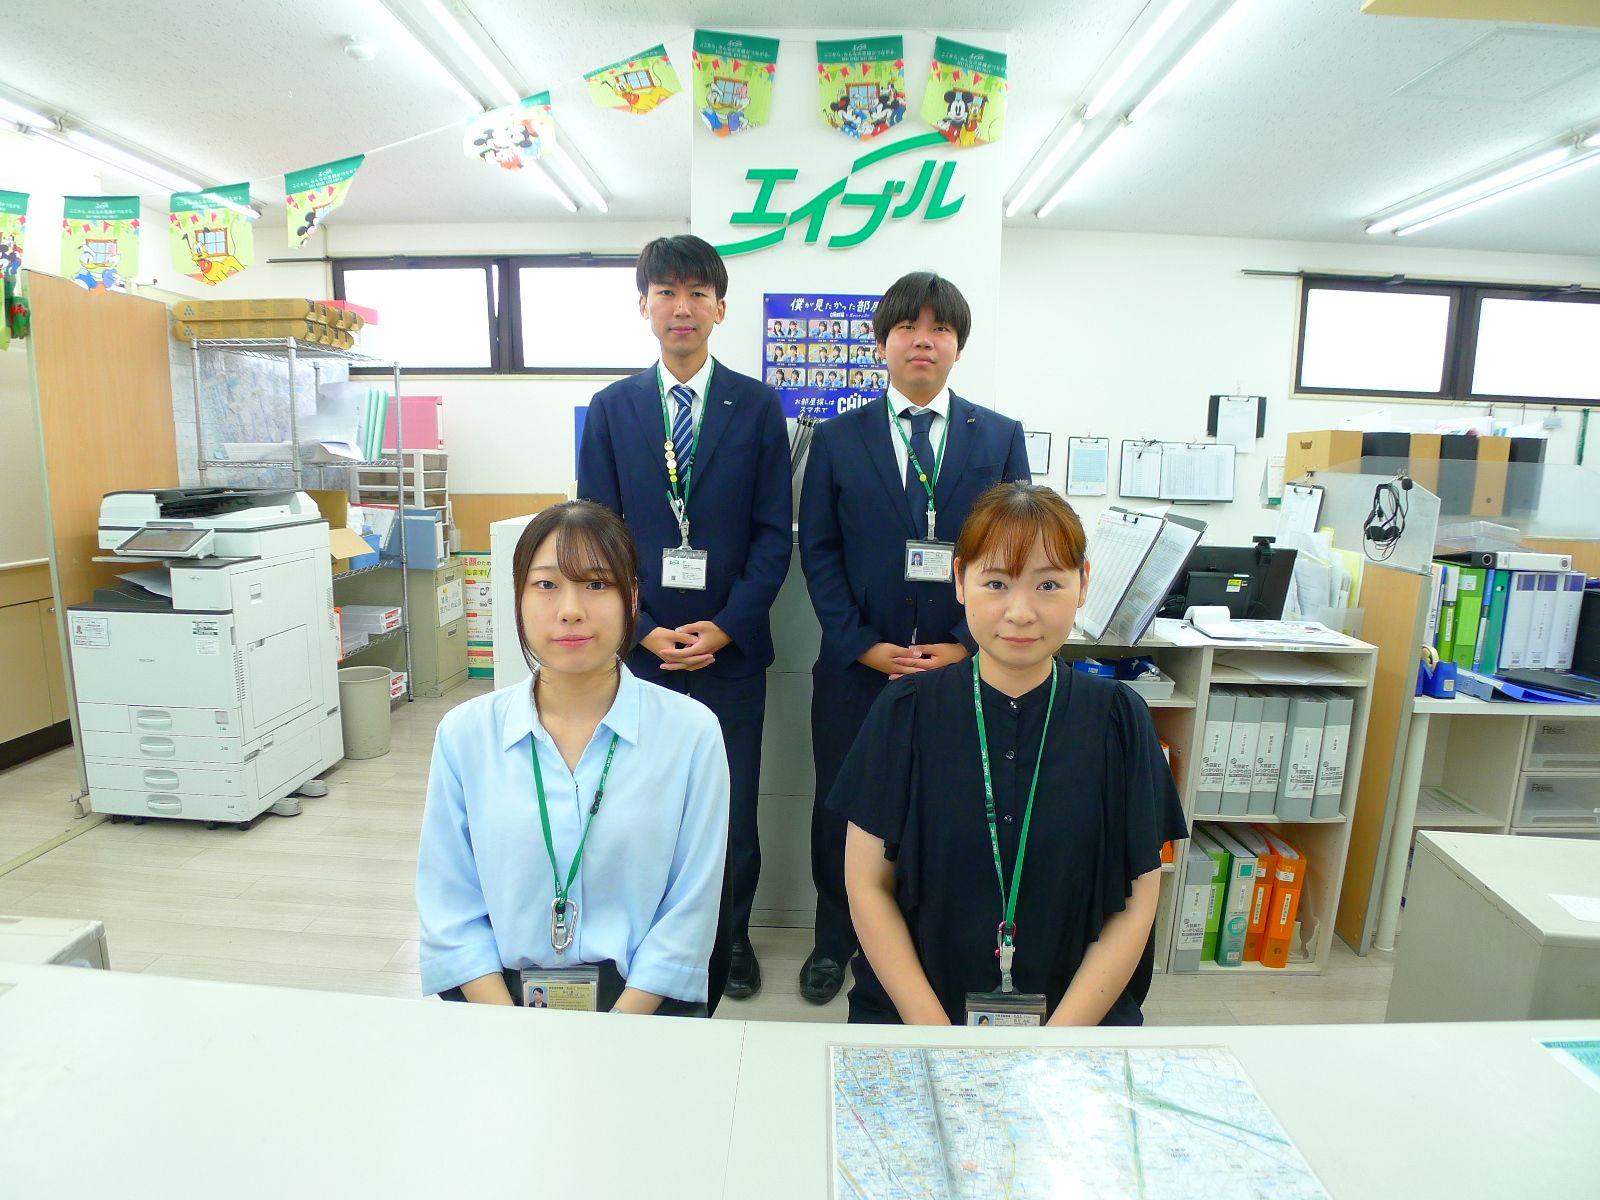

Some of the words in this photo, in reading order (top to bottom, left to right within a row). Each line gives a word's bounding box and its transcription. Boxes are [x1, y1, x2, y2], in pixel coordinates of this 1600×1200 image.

[729, 160, 966, 249] エイブル
[794, 397, 835, 406] お部屋探しは
[799, 406, 828, 414] スマホで
